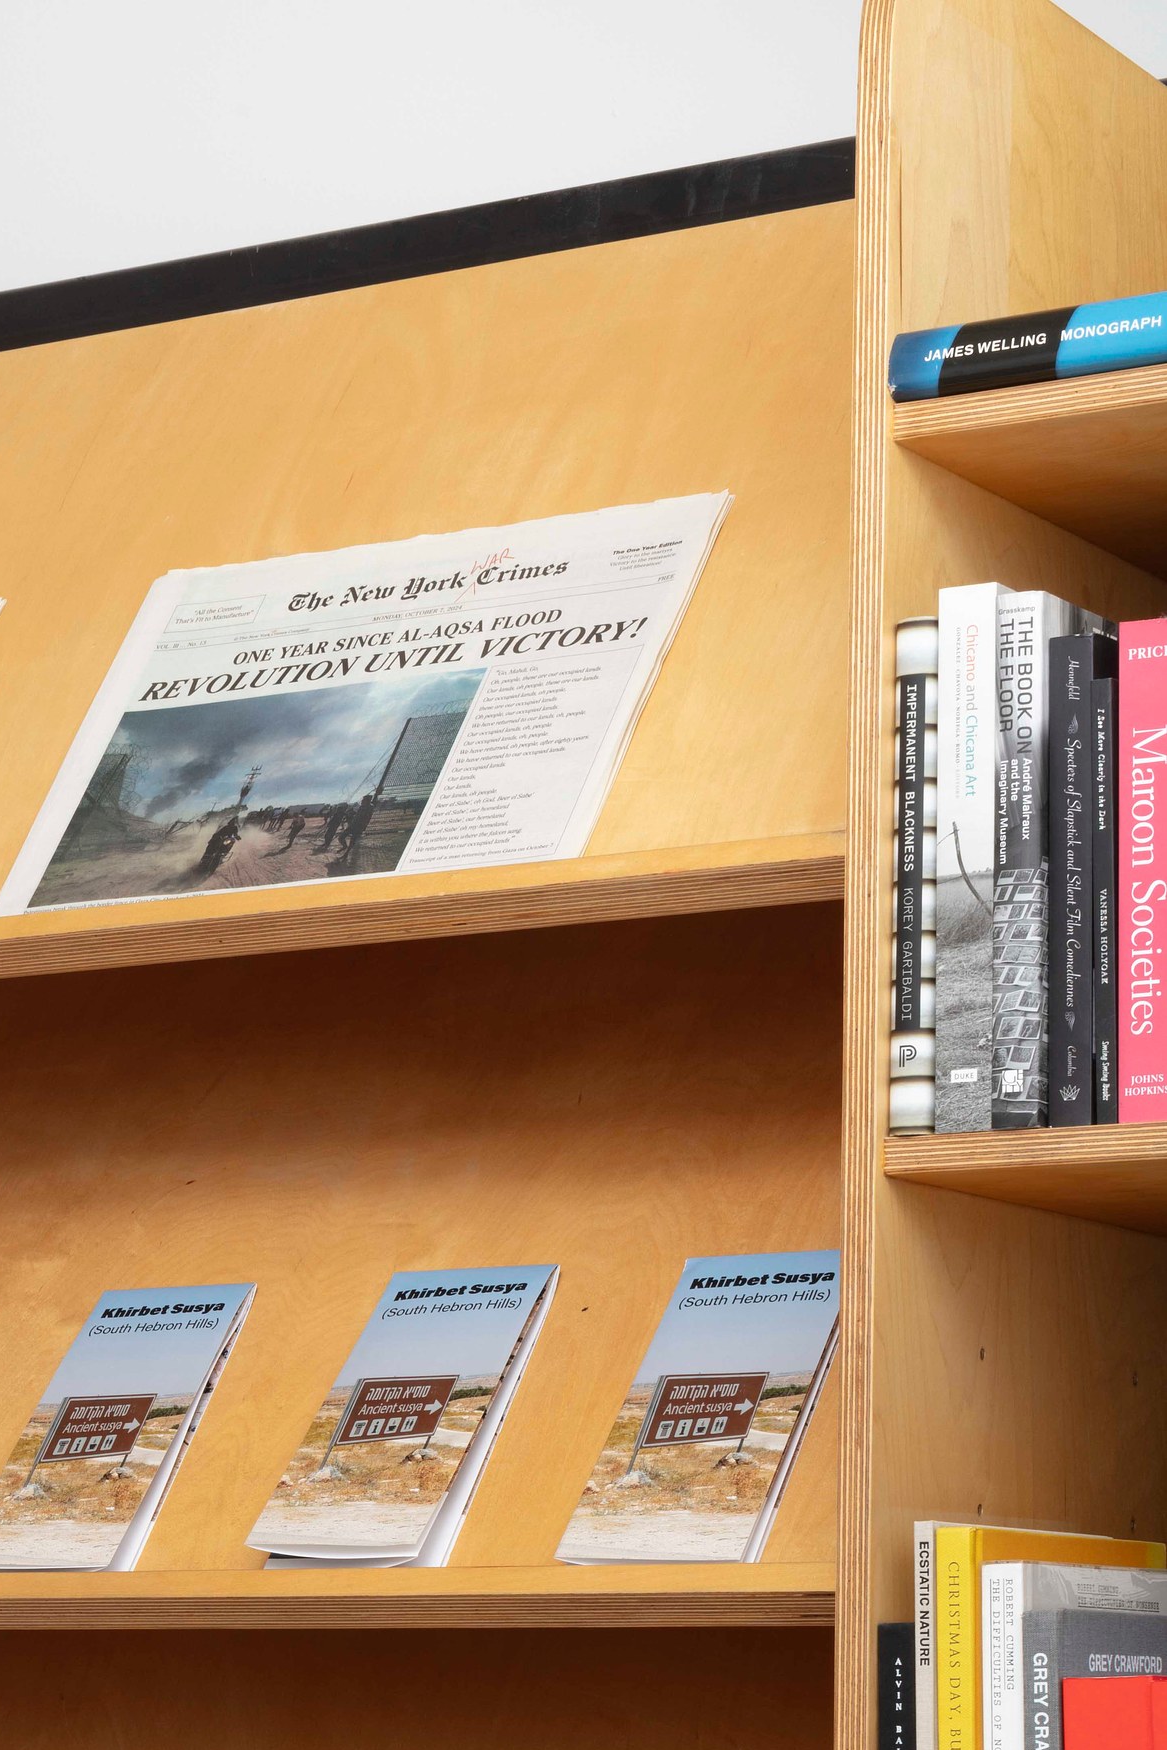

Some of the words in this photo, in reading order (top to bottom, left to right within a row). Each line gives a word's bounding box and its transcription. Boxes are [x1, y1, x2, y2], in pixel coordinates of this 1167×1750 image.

[924, 343, 974, 362] JAMES
[977, 332, 1047, 355] WELLING
[1060, 315, 1162, 342] MONOGRAPH
[288, 591, 334, 612] The
[340, 585, 395, 607] New
[400, 571, 468, 600] York
[477, 561, 569, 586] Crimes
[138, 658, 358, 701] REVOLUTION
[365, 643, 465, 673] UNTIL
[480, 617, 648, 658] VICTORY!
[233, 649, 274, 665] ONE
[280, 641, 329, 660] YEAR
[333, 632, 394, 652] SINCE
[398, 620, 483, 643] AL-AQSA
[491, 609, 562, 630] FLOOD
[965, 625, 978, 681] Chicano
[1000, 618, 1014, 659] THE
[1017, 616, 1033, 656] THE
[965, 685, 978, 711] and
[1000, 665, 1013, 732] FLOOR
[1017, 662, 1033, 721] BOOK
[1065, 656, 1080, 700] Hennefeld
[905, 684, 917, 781] IMPERMANENT
[965, 715, 977, 770] Chicana
[1017, 726, 1032, 754] ON
[1022, 758, 1032, 791] André
[1064, 738, 1082, 782] Specters
[965, 775, 977, 796] Art
[998, 760, 1009, 815] Imaginary
[1065, 785, 1082, 797] of
[1131, 725, 1167, 868] Maroon
[903, 791, 915, 872] BLACKNESS
[1022, 794, 1032, 840] Malraux
[1064, 799, 1082, 846] Slapstick
[999, 818, 1008, 864] Museum
[1067, 850, 1082, 870] and
[903, 888, 913, 931] KOREY
[1066, 874, 1082, 905] Silent
[1066, 908, 1081, 935] Film
[1066, 939, 1081, 1007] Comediennes
[1130, 880, 1166, 1035] Societies
[901, 941, 913, 1021] GARIBALDI
[394, 1285, 467, 1301] Khirbet
[469, 1283, 527, 1295] Susya
[679, 1295, 727, 1310] (South
[732, 1292, 787, 1304] Hebron
[792, 1289, 830, 1302] Hills)
[690, 1274, 769, 1289] Khirbet
[771, 1272, 835, 1285] Susya
[89, 1324, 131, 1336] (South
[134, 1320, 182, 1332] Hebron
[185, 1318, 219, 1329] Hills)
[101, 1305, 170, 1318] Khirbet
[171, 1303, 225, 1314] Susya
[382, 1304, 427, 1320] (South
[431, 1301, 482, 1313] Hebron
[486, 1298, 521, 1309] Hills)
[358, 1404, 397, 1415] Ancient
[397, 1403, 423, 1412] susya
[663, 1403, 706, 1415] Ancient
[706, 1401, 732, 1412] susya
[919, 1541, 930, 1606] ECSTATIC
[992, 1579, 1000, 1602] THE
[948, 1561, 960, 1668] CHRISTMAS
[1005, 1579, 1014, 1626] ROBERT
[919, 1610, 930, 1667] NATURE
[993, 1611, 1002, 1706] DIFFICULTIES
[1006, 1634, 1015, 1691] CUMMING
[1033, 1652, 1048, 1706] GREY
[948, 1677, 961, 1721] DAY,
[994, 1714, 1002, 1731] OF
